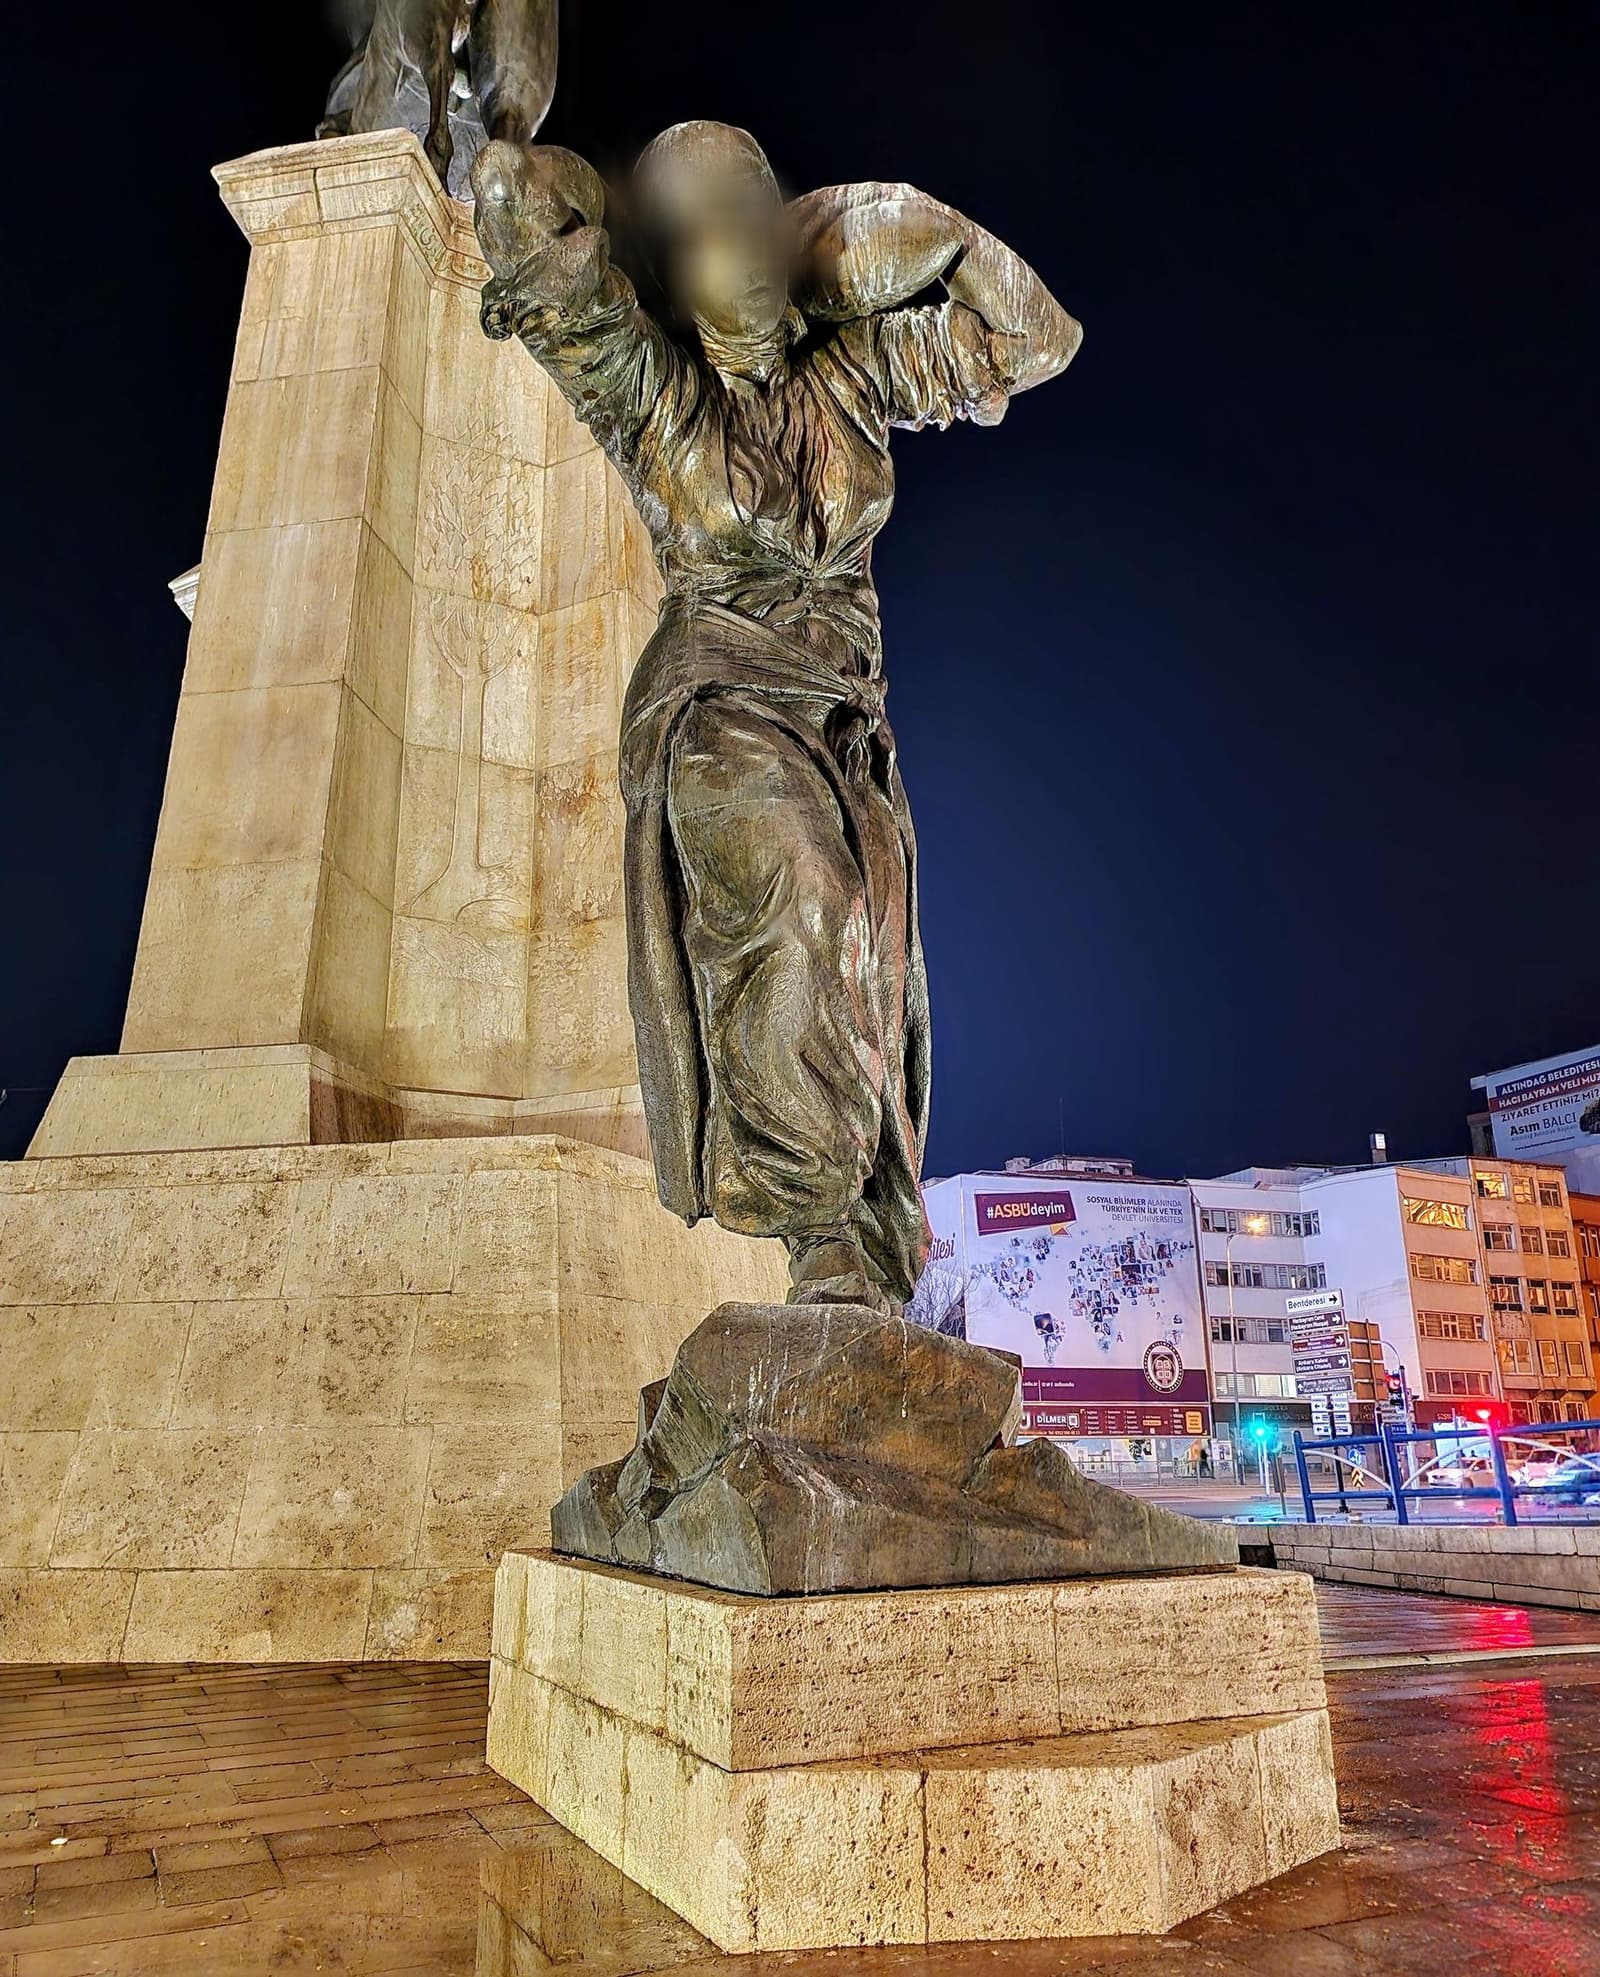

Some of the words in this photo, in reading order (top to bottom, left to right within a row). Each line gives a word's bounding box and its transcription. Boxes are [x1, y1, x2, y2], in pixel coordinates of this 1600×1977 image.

[1499, 1095, 1521, 1108] HACI
[1521, 1085, 1560, 1102] BAYRAM
[1542, 1112, 1577, 1129] BALCI
[1086, 1195, 1113, 1204] SOSYAL
[1111, 1213, 1137, 1222] DEVLET
[1159, 1207, 1169, 1215] VE
[1170, 1207, 1183, 1216] TEK
[1287, 1295, 1326, 1310] Bentderesi
